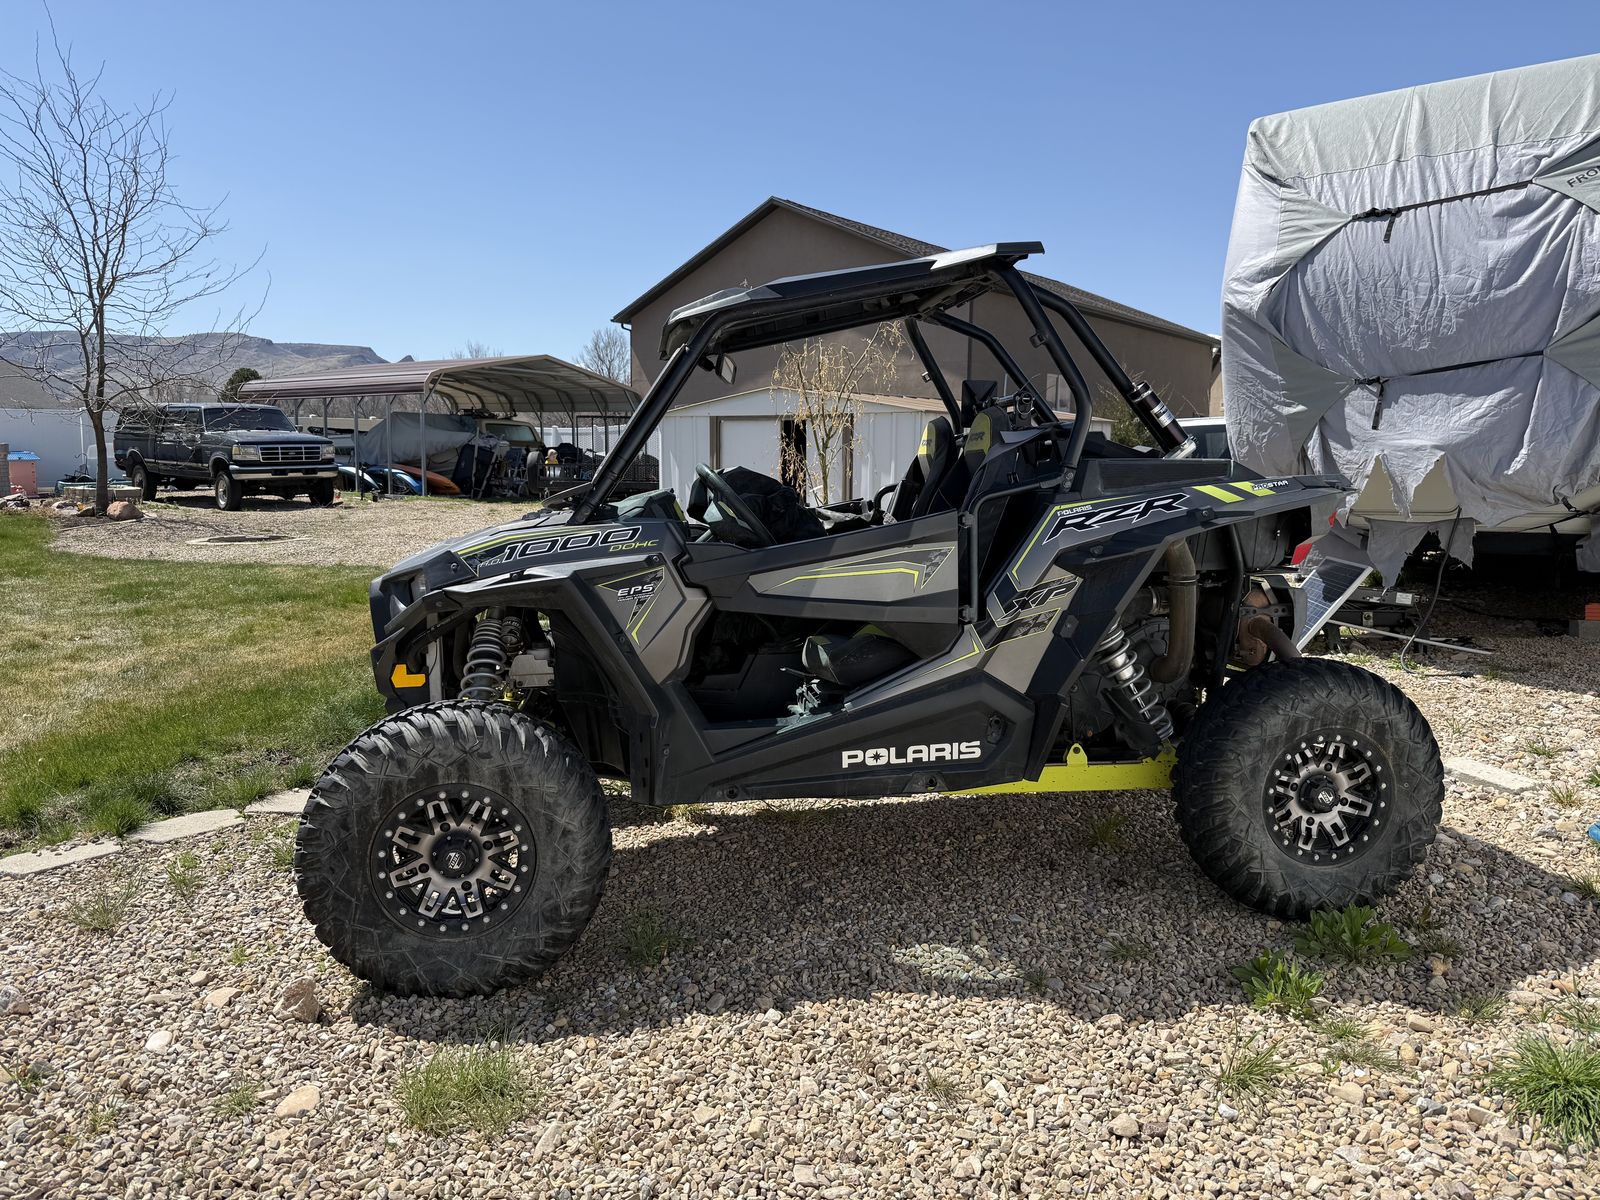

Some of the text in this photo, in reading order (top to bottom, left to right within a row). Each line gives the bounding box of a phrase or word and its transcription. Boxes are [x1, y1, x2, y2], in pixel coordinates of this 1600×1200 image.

[1042, 492, 1190, 546] RZR
[1057, 504, 1093, 517] POLARIS
[502, 525, 642, 563] 1000
[608, 539, 660, 552] DOHC
[617, 583, 654, 596] EPS
[996, 579, 1079, 622] XP
[841, 740, 982, 769] POLARIS
